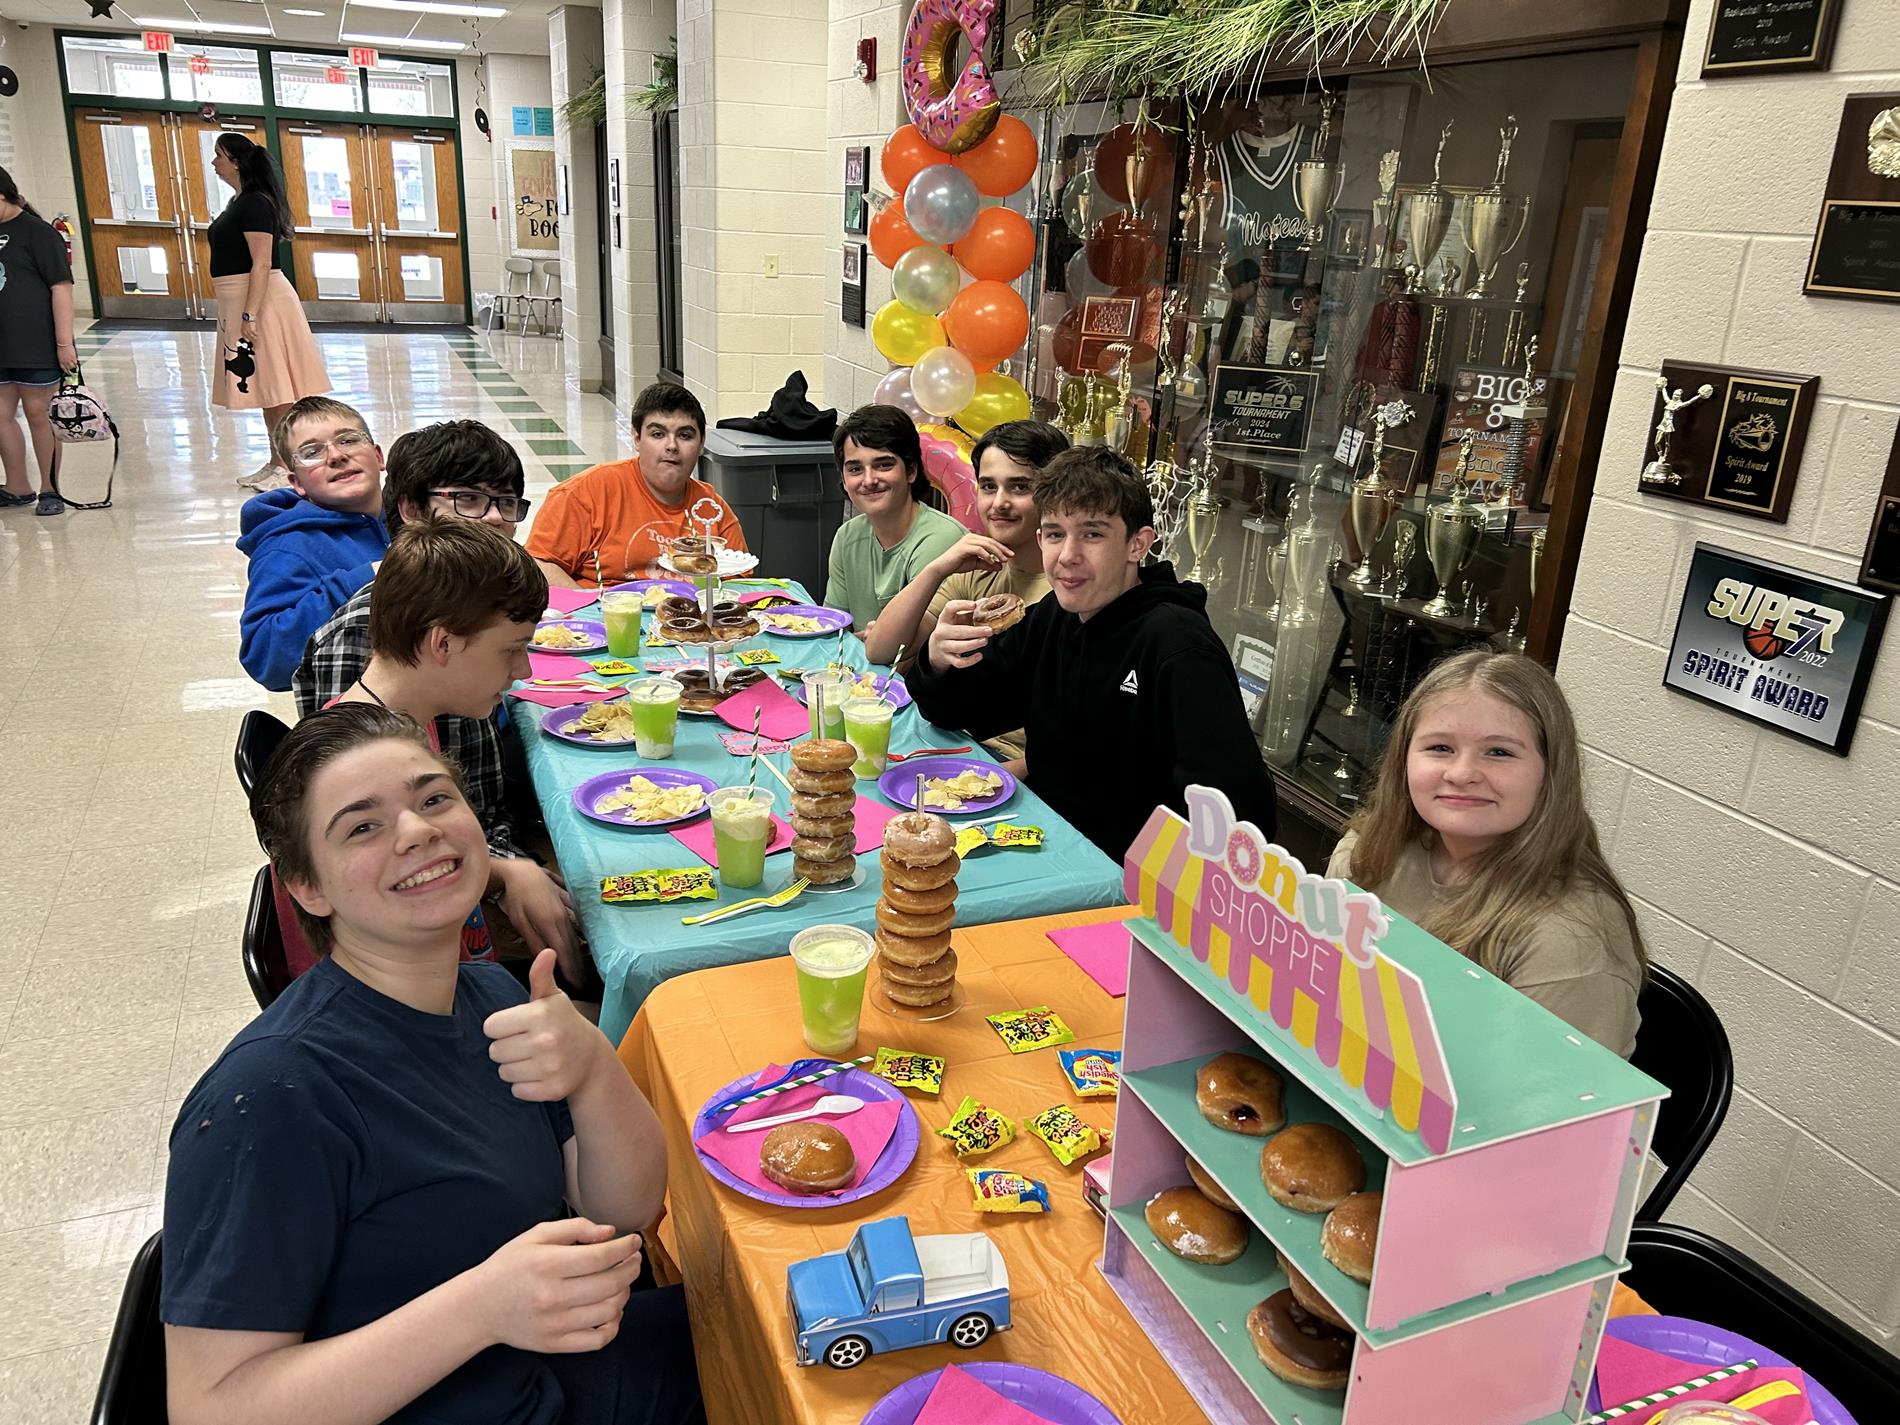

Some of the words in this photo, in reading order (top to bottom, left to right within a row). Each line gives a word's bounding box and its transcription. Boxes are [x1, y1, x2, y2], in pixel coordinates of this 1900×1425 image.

[148, 32, 171, 51] EXIT
[353, 48, 375, 67] EXIT
[1473, 374, 1529, 403] BIG
[1751, 391, 1789, 407] Tournament
[1223, 389, 1288, 410] SUPER
[1288, 395, 1305, 410] 6
[1232, 406, 1292, 420] TOURNAMENT
[1249, 418, 1271, 429] 2024
[1485, 403, 1505, 428] 8
[1725, 455, 1745, 470] Spirit
[1744, 459, 1770, 472] Award
[1734, 473, 1753, 485] 2019
[1706, 577, 1846, 654] SUPER
[1783, 615, 1828, 658] 7
[1714, 646, 1803, 683] TOURNAMENT
[1798, 649, 1828, 669] 2022
[1682, 648, 1749, 694] SPIRIT
[1750, 674, 1830, 723] AWARD
[1187, 788, 1380, 963] Donut
[1209, 873, 1332, 997] SHOPPE
